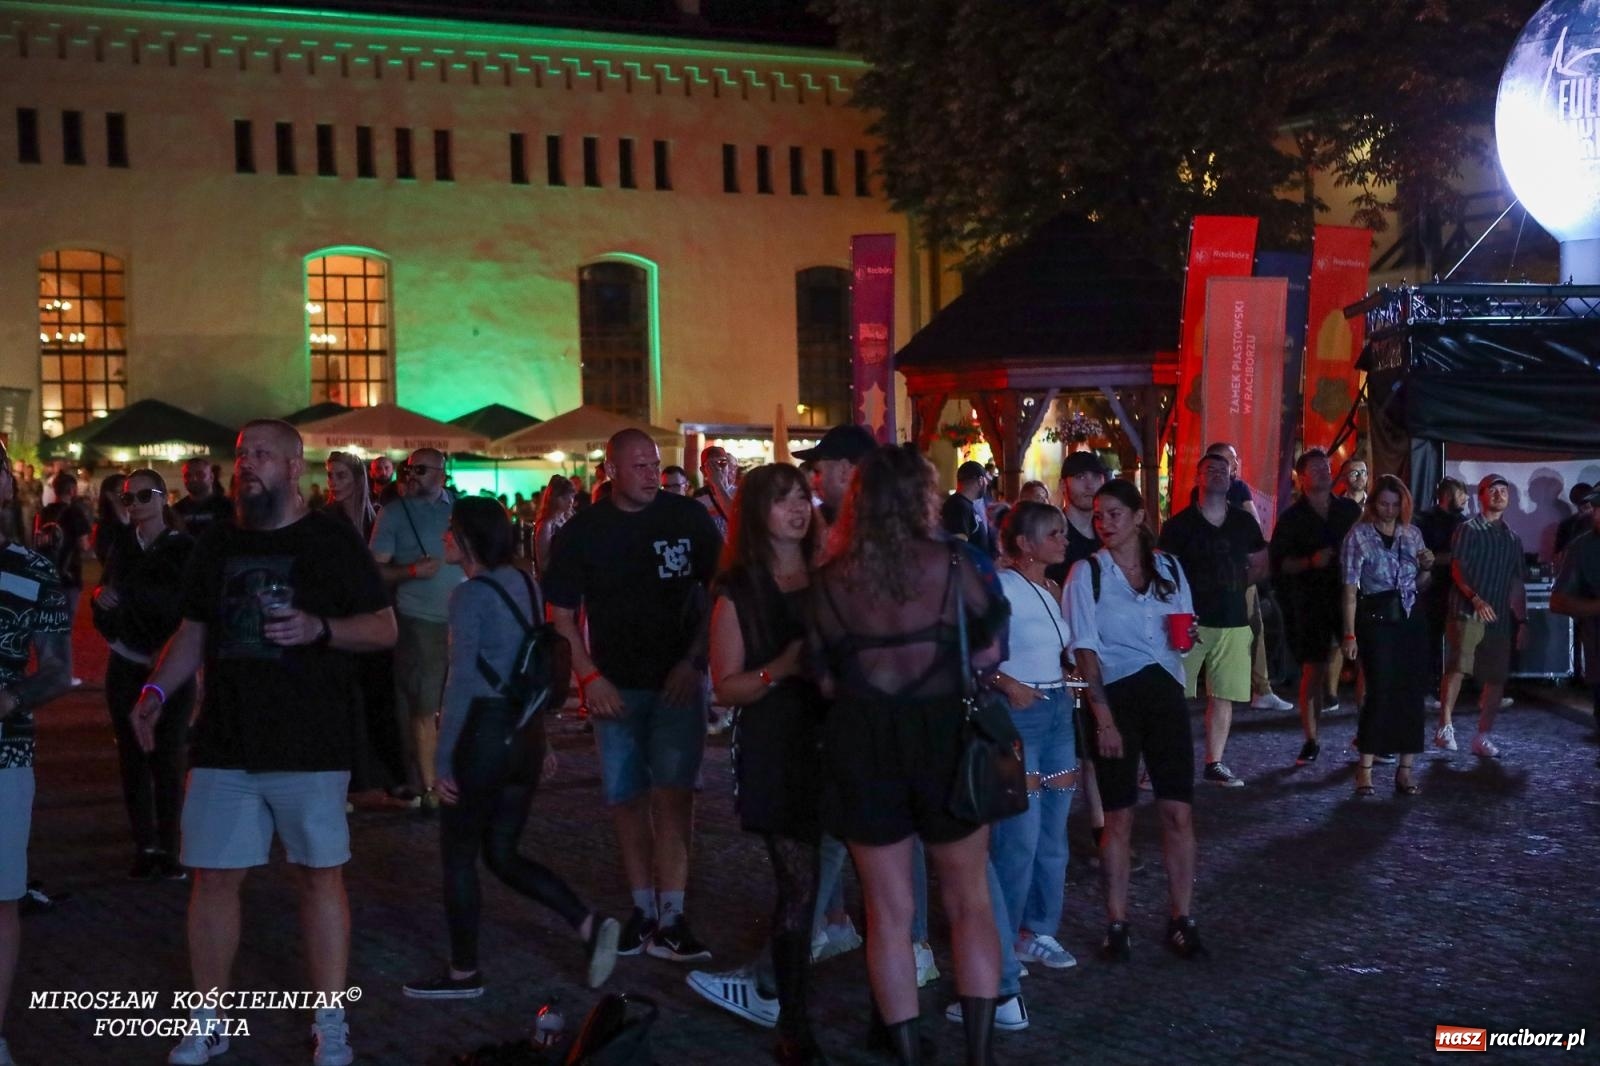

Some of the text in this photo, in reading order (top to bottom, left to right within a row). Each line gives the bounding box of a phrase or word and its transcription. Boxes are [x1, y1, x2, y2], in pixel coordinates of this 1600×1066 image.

[1558, 78, 1600, 120] FUL
[1230, 300, 1244, 415] ZAMEK PIASTOWSKI
[1243, 335, 1256, 415] W RACIBORZU
